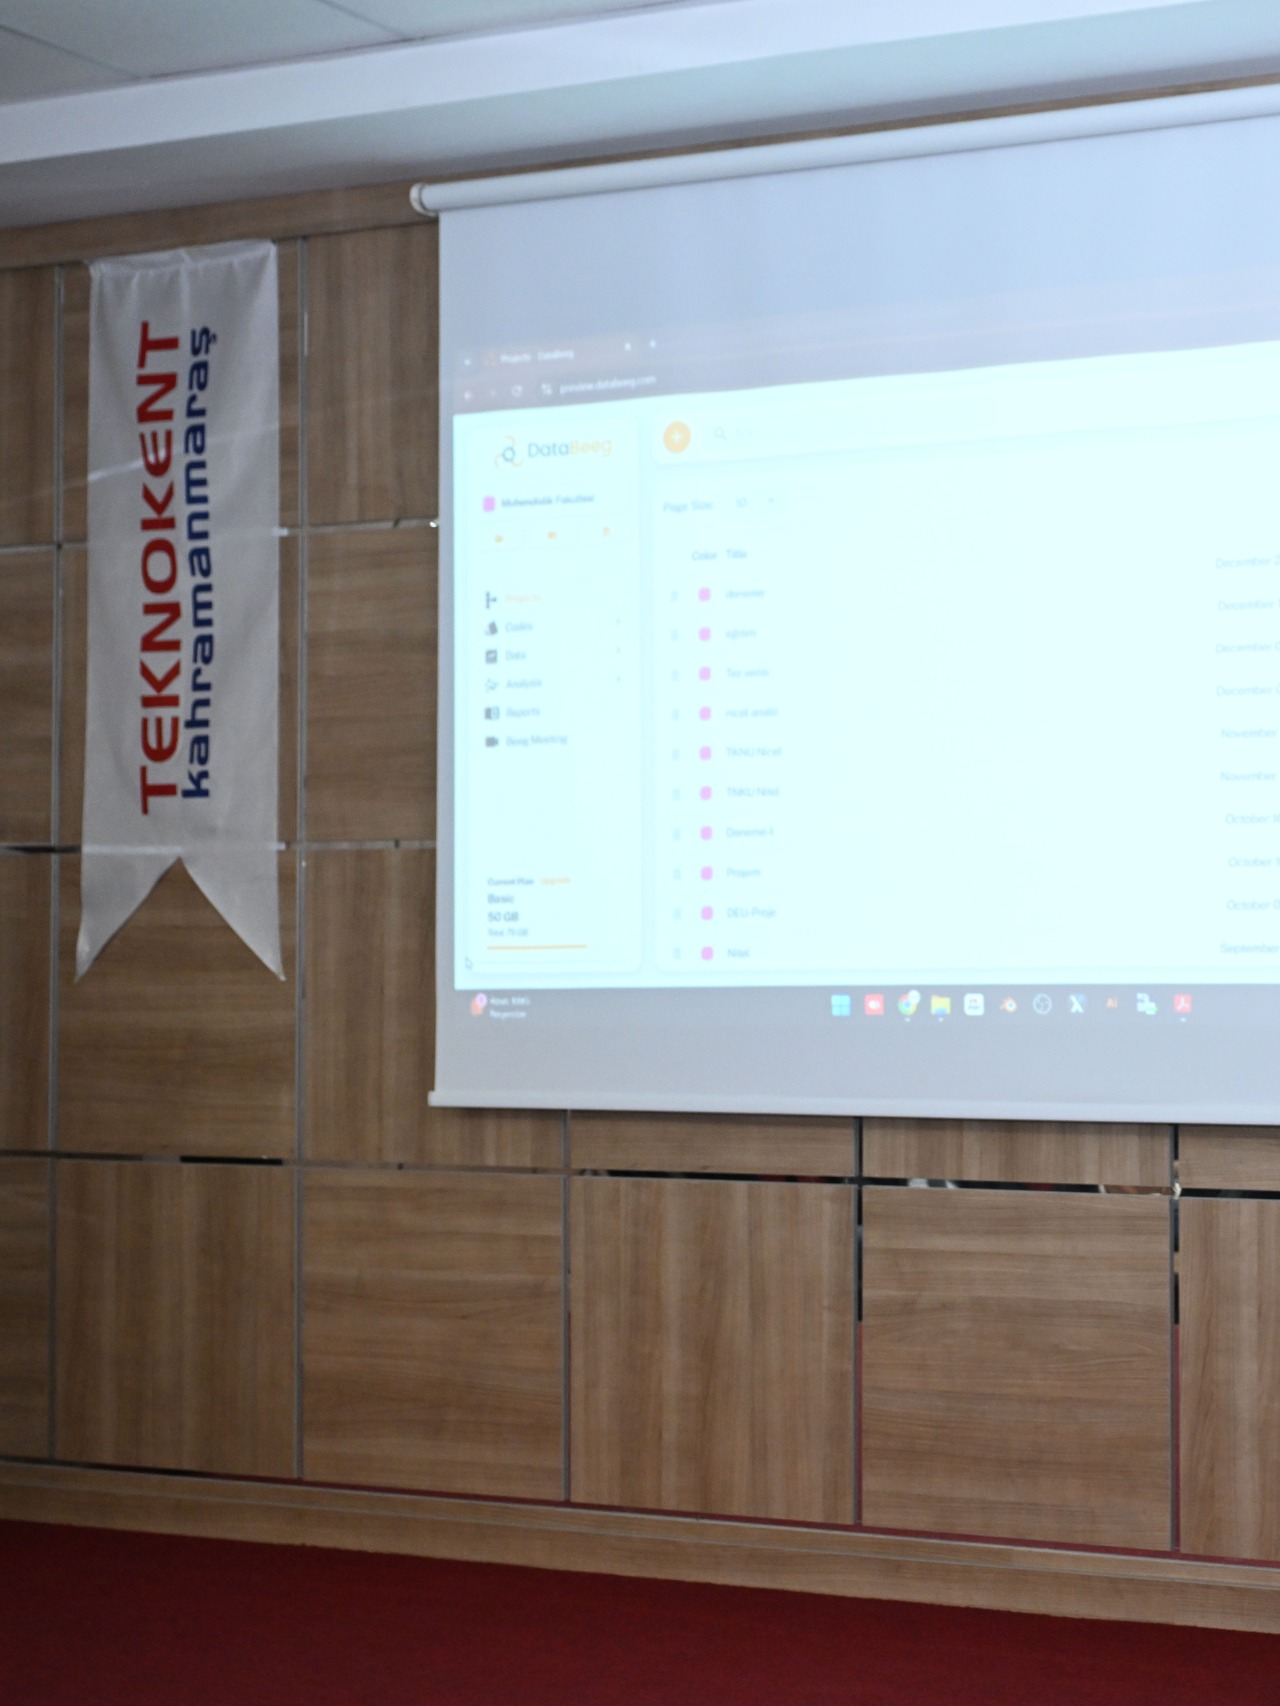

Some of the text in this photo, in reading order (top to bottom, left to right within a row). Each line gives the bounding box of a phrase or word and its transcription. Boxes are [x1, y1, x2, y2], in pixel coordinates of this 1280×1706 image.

[527, 439, 613, 459] DataBeeg
[690, 547, 748, 562] Color Title
[137, 322, 181, 814] TEKNOKENT
[181, 326, 217, 799] kahramanmaraş
[1216, 556, 1271, 569] December
[1218, 599, 1275, 611] December
[1216, 641, 1272, 654] December
[1216, 684, 1272, 696] December
[1220, 727, 1277, 739] November
[1220, 770, 1276, 782] November
[1225, 812, 1270, 824] October
[1228, 856, 1272, 868] October
[1226, 898, 1270, 910] October
[1220, 942, 1280, 956] September
